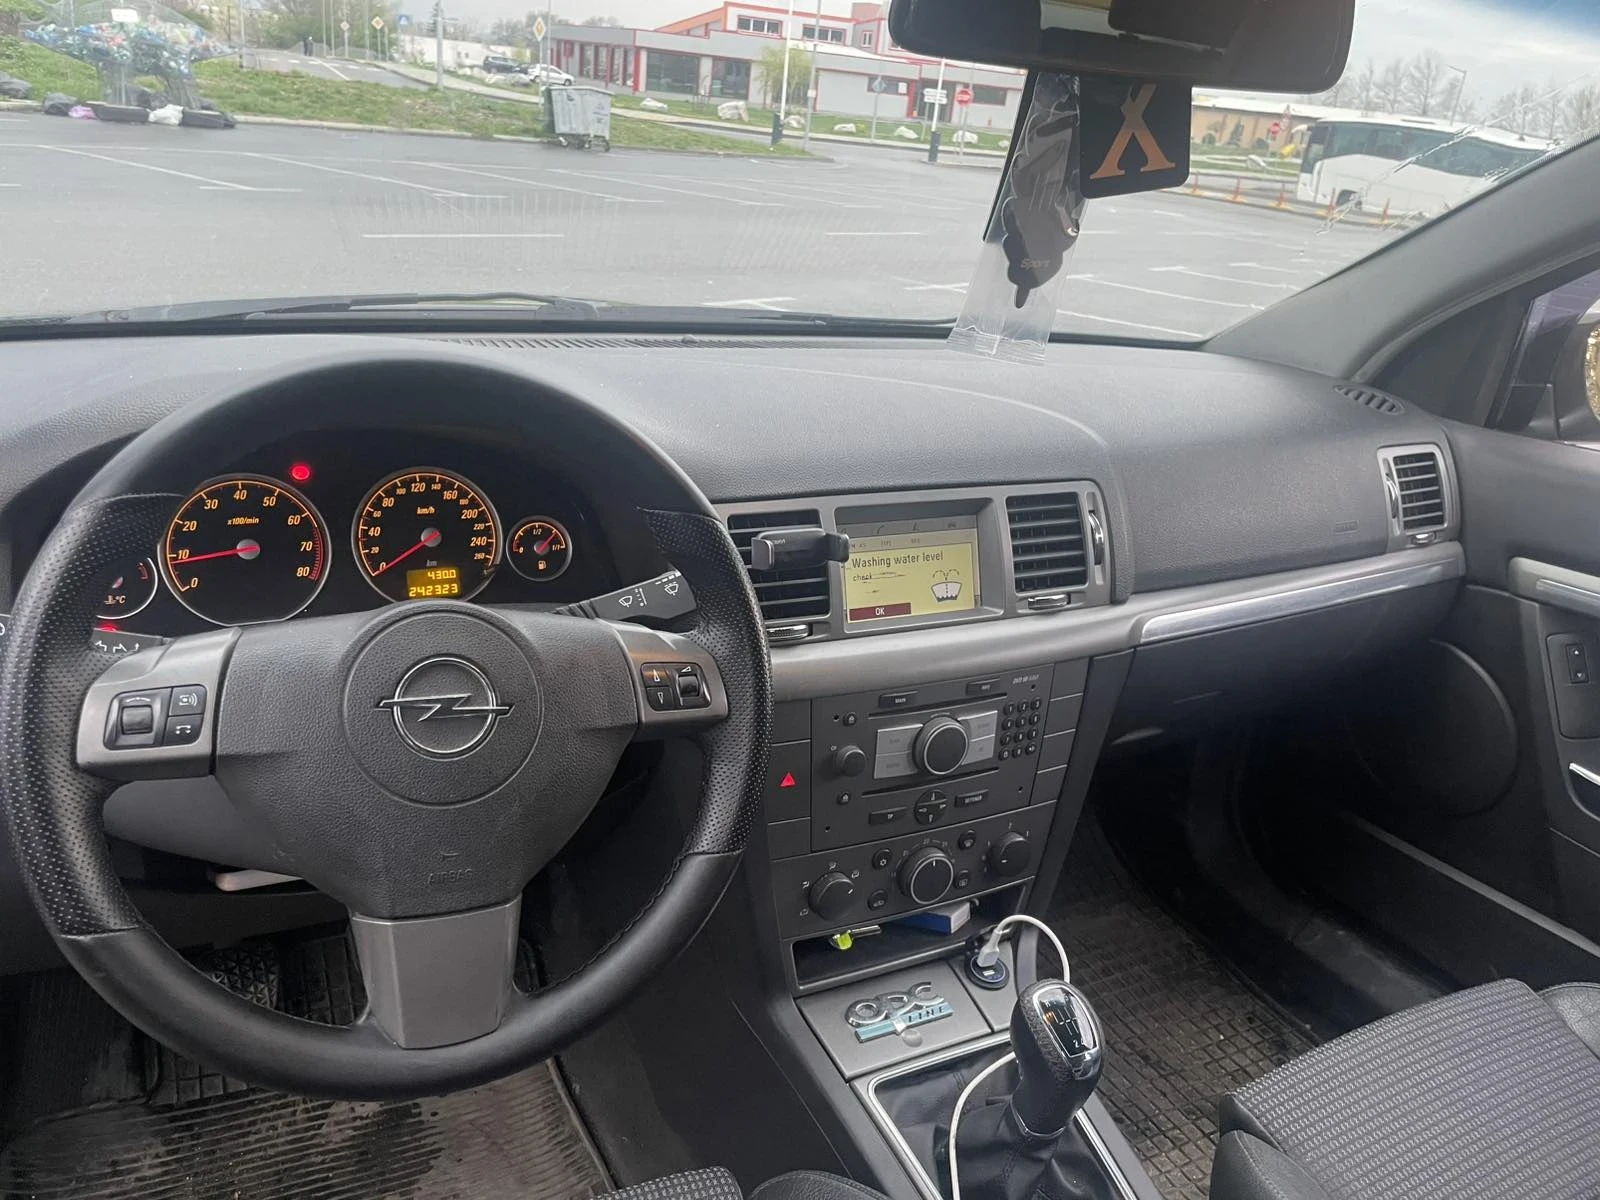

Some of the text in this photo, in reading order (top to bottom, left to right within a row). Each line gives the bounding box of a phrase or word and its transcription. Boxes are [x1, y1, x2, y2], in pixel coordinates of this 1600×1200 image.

[411, 482, 426, 492] 120
[233, 489, 247, 500] 40
[443, 490, 458, 500] 160
[204, 499, 218, 510] 30
[262, 496, 276, 507] 50
[382, 497, 395, 507] 80
[416, 506, 435, 515] km/h
[461, 509, 478, 519] 200
[182, 520, 197, 532] 20
[227, 517, 259, 526] x100/min
[287, 515, 301, 526] 60
[368, 526, 381, 537] 40
[300, 541, 313, 552] 70
[470, 536, 487, 546] 240
[178, 549, 189, 560] 10
[370, 546, 380, 554] 20
[474, 552, 485, 560] 260
[851, 550, 944, 569] Washing water level
[296, 566, 309, 577] 80
[379, 562, 386, 571] 0
[190, 577, 198, 588] 0
[852, 572, 872, 582] check
[409, 583, 458, 597] 242323
[875, 607, 885, 616] OK
[845, 981, 944, 1028] OPC
